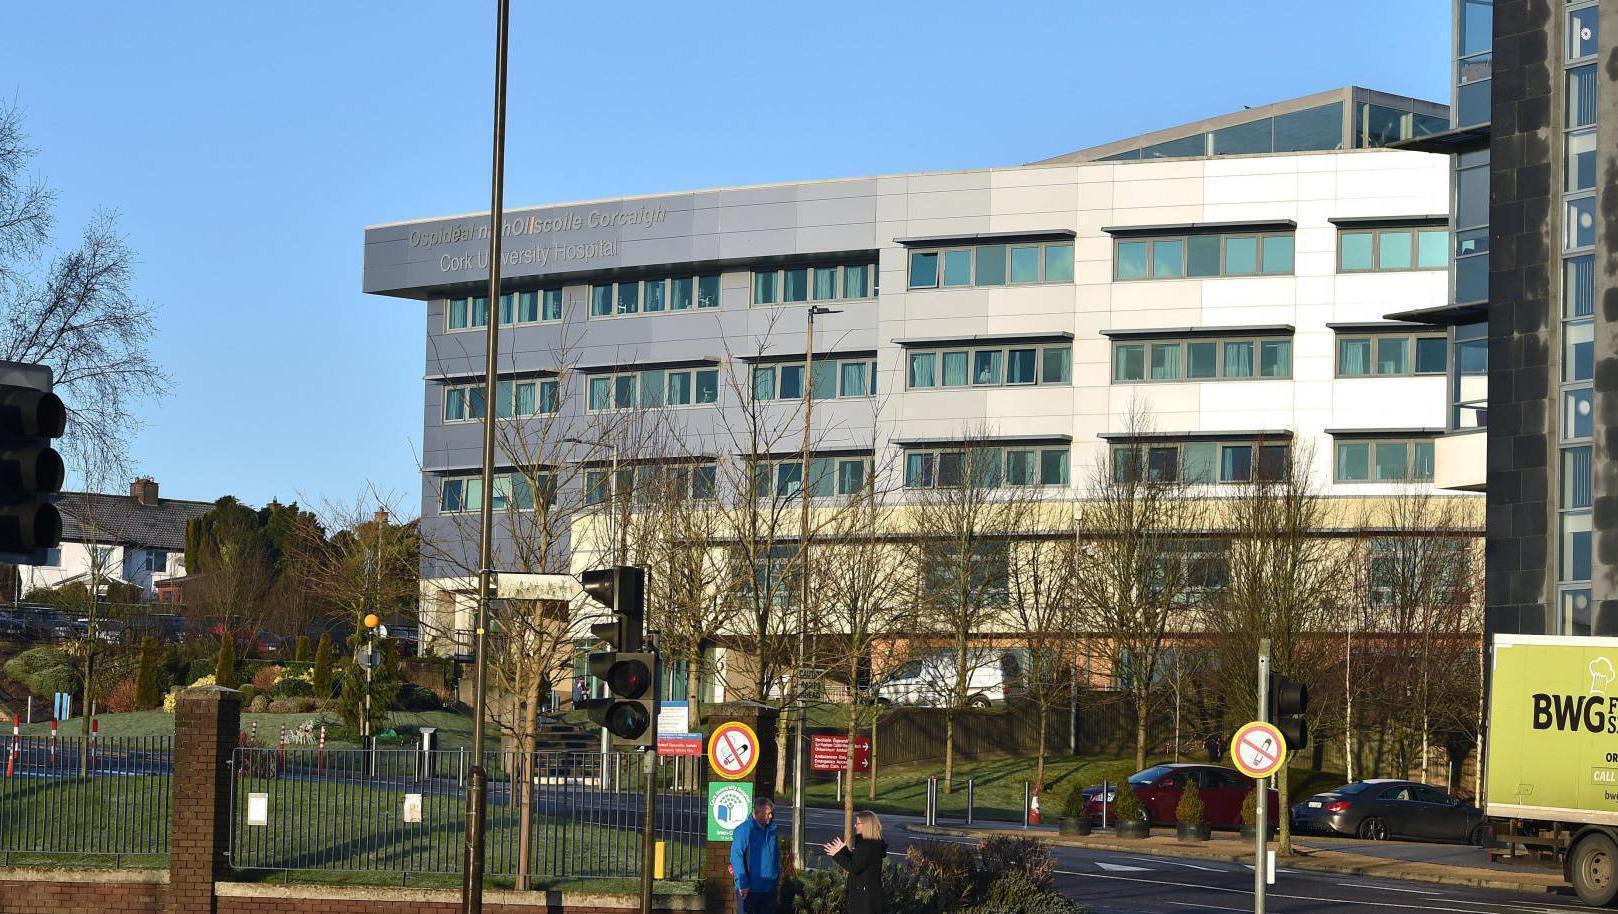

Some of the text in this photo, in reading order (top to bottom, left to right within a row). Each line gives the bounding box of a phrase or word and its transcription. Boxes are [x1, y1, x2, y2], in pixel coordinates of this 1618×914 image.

[409, 223, 476, 250] Ospidéal
[587, 205, 667, 229] Corcaigh
[440, 238, 618, 272] Cork Uversity Hospital
[1532, 693, 1605, 733] BWG
[1594, 771, 1616, 782] CALL
